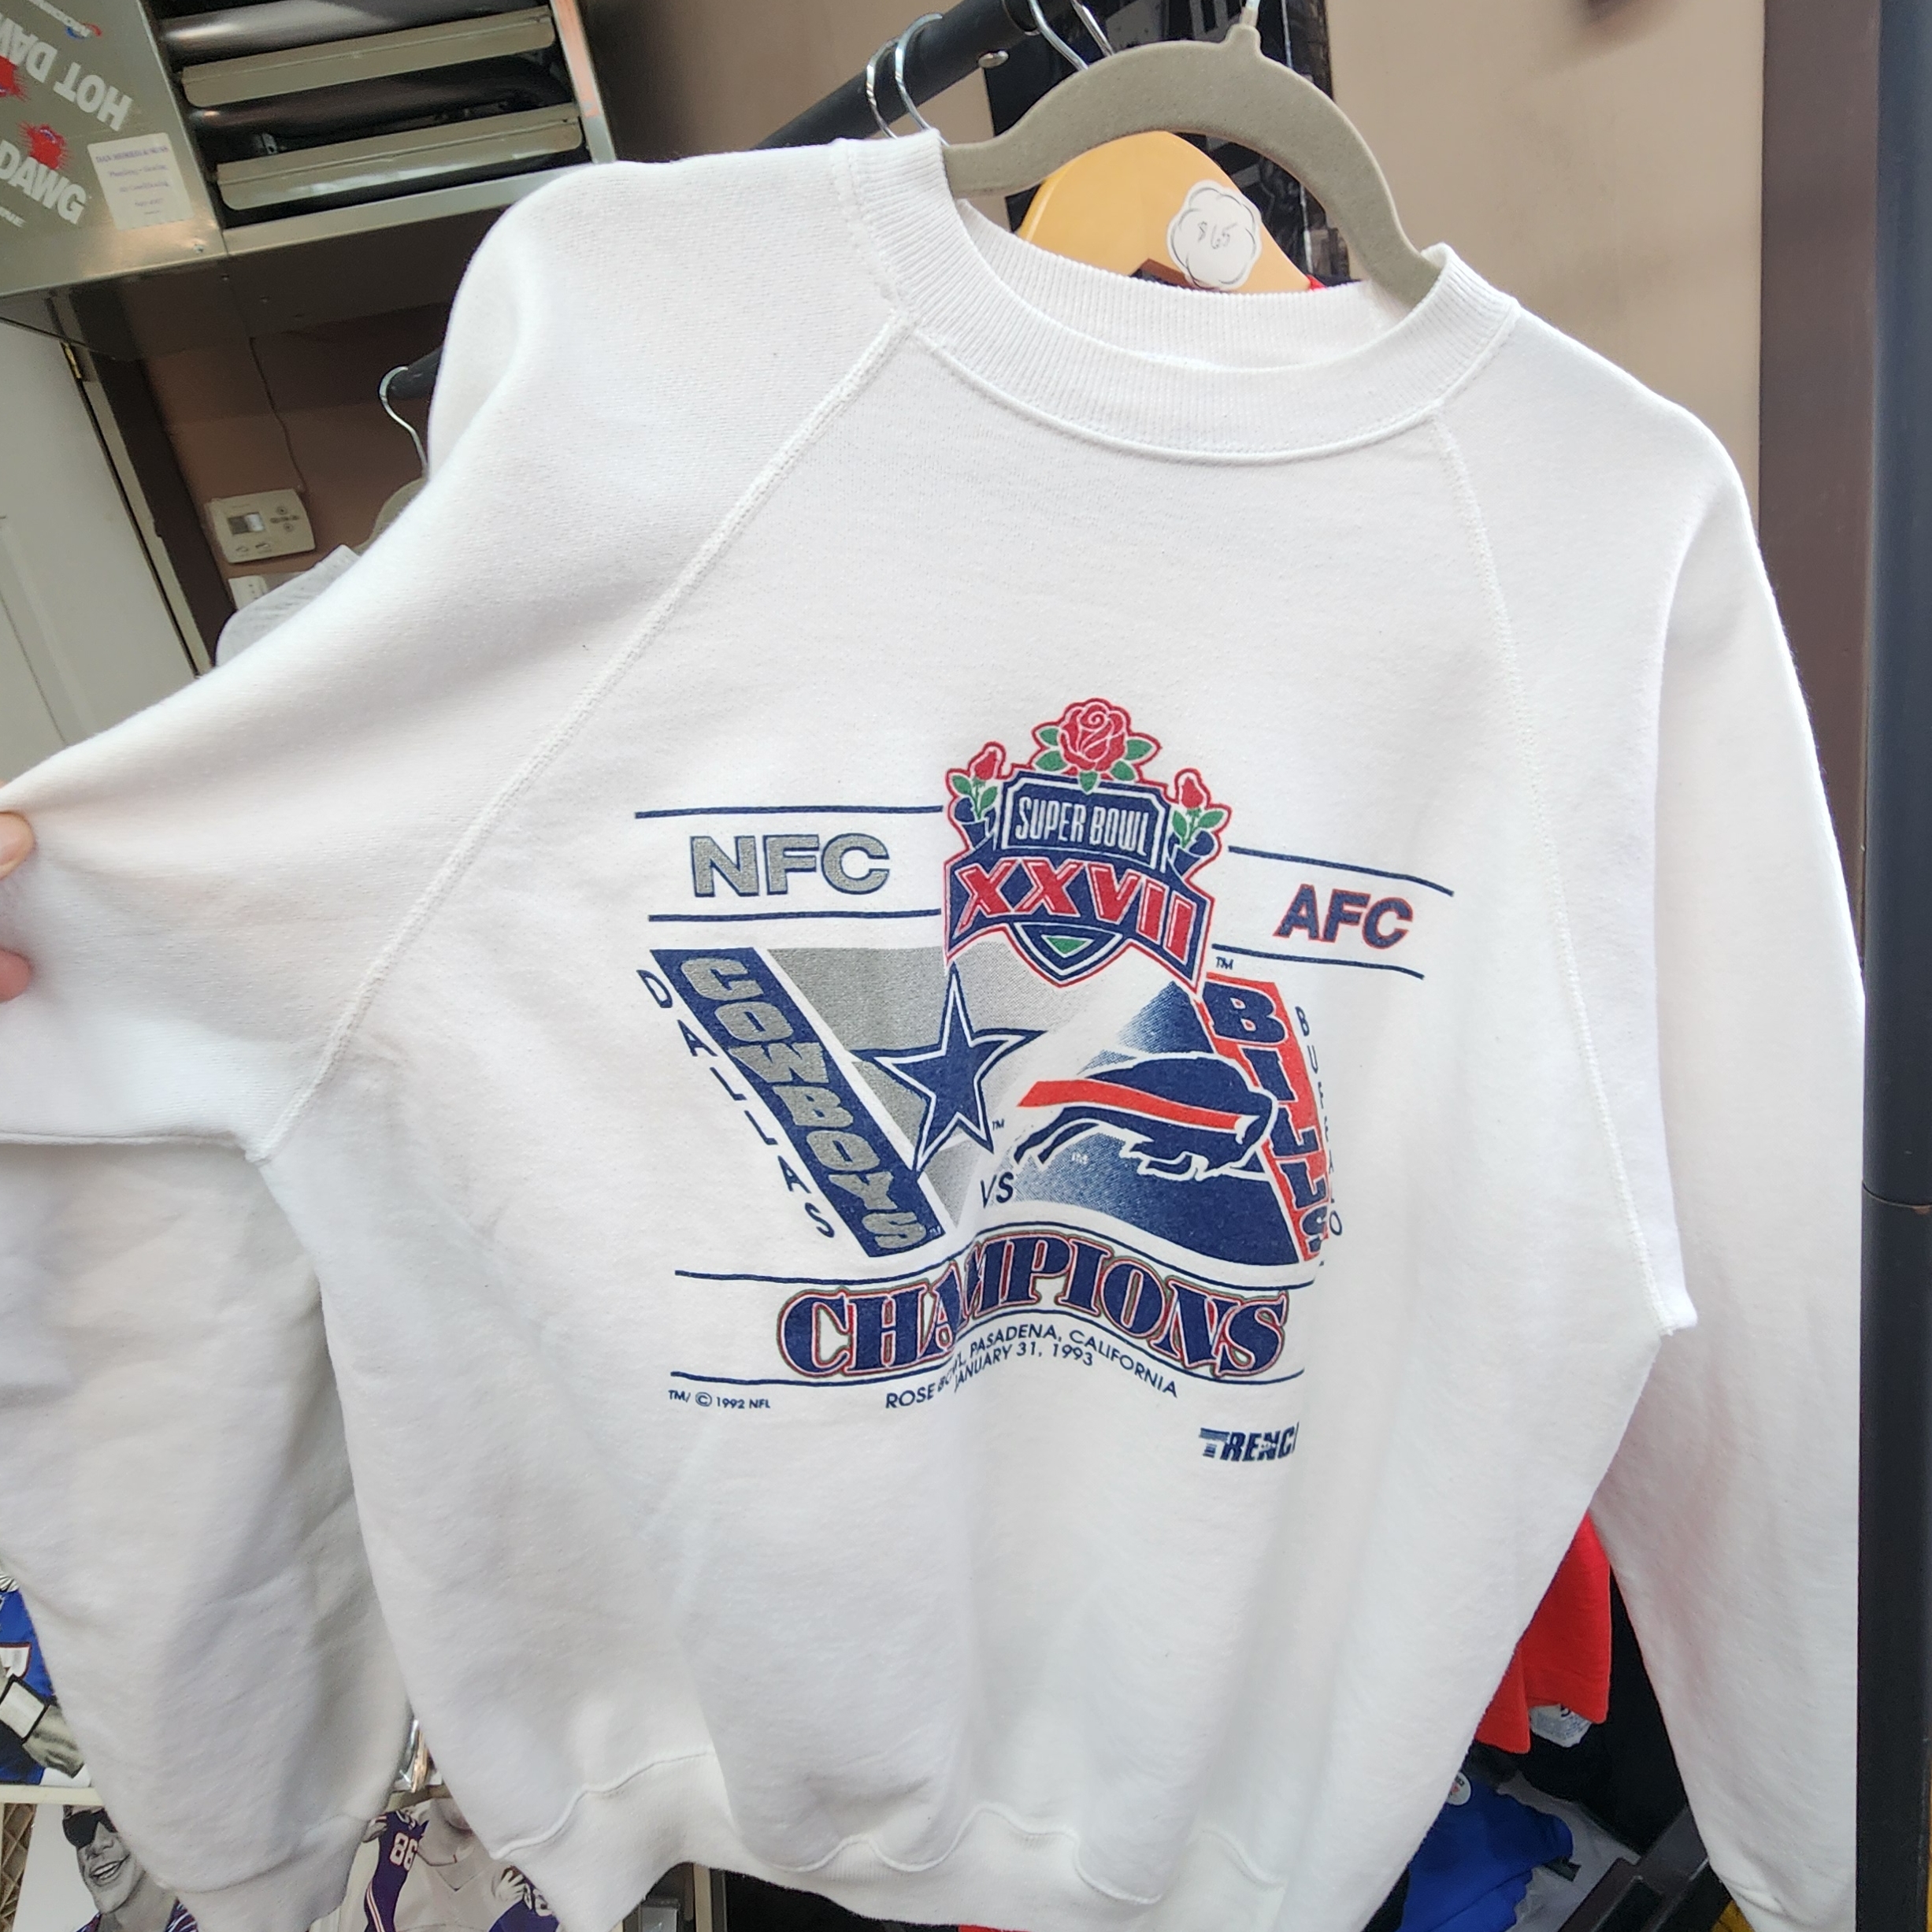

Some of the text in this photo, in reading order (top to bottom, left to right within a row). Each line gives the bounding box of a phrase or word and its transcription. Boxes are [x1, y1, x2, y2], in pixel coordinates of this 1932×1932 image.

[53, 61, 134, 132] HOT
[0, 140, 86, 224] DAWG
[1015, 796, 1149, 856] SUPER BOWL
[690, 833, 890, 897] NFC
[947, 857, 1196, 965] XXVII
[1273, 884, 1413, 950] AFC
[1215, 956, 1233, 970] TM
[637, 970, 834, 1238] DALLAS
[680, 958, 926, 1249] COWBOYS
[1202, 981, 1328, 1253] BILLS
[980, 1171, 1014, 1209] VS
[777, 1232, 1289, 1378] CHAMPIONS
[885, 1382, 936, 1408] ROSE
[970, 1324, 1062, 1358] PASADENA,
[1069, 1329, 1177, 1398] CALIFORNIA
[954, 1341, 1093, 1393] JANUARY 31, 1993
[716, 1396, 745, 1409] 1992
[749, 1399, 770, 1409] NFL
[389, 1832, 418, 1871] 86
